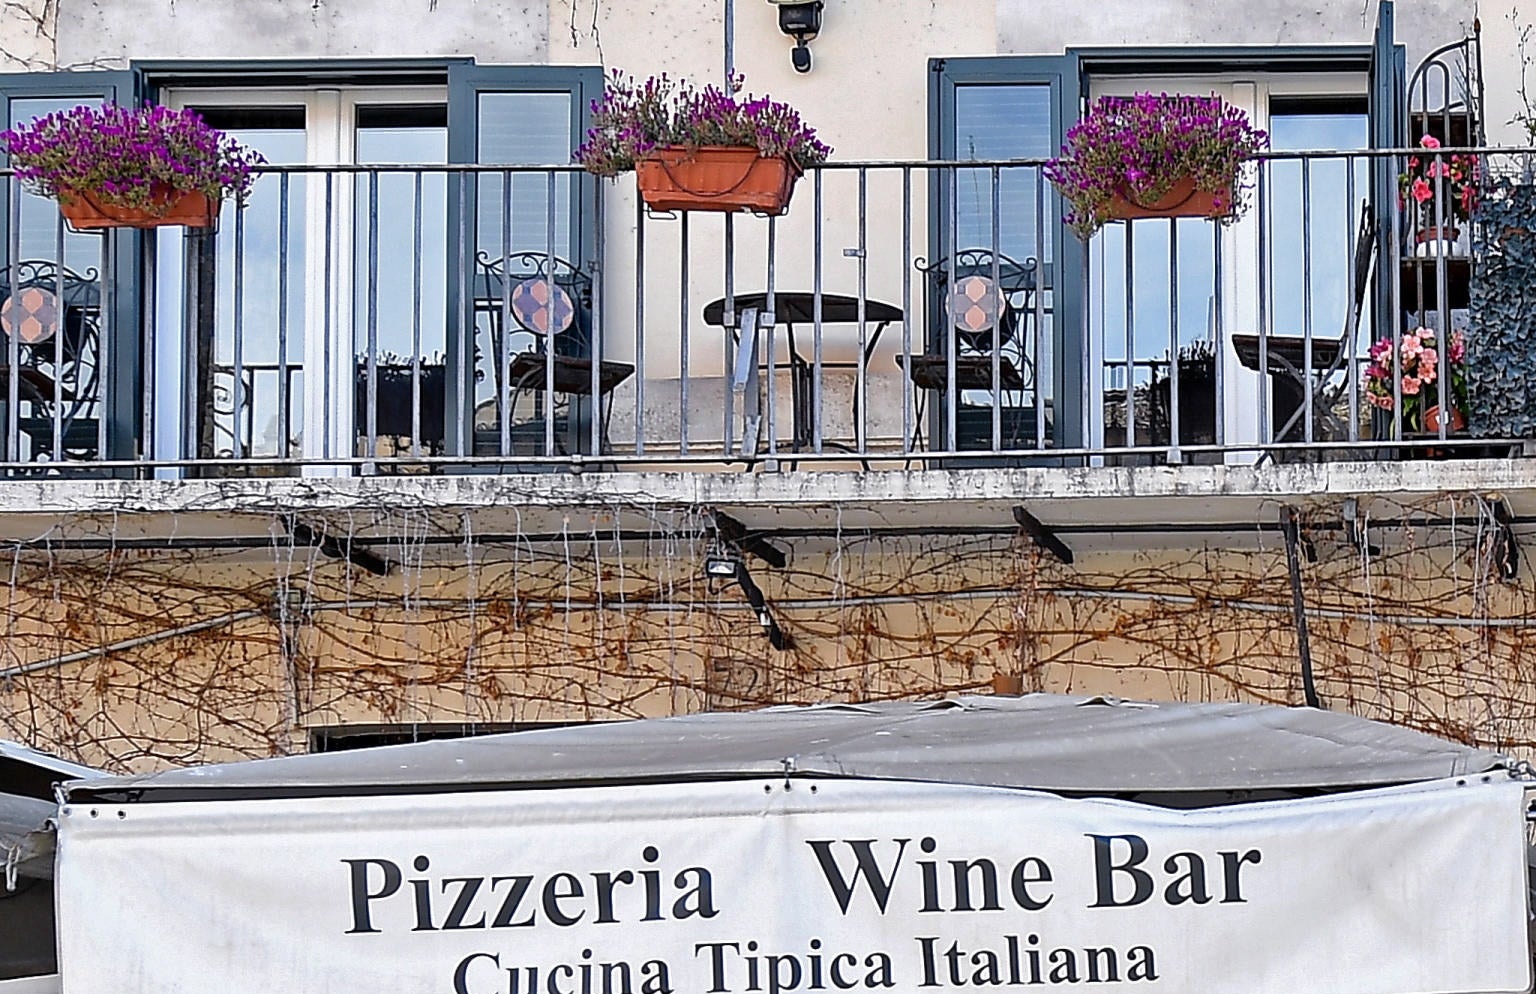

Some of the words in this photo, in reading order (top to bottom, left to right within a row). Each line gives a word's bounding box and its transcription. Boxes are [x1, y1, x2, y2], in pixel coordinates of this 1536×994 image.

[341, 845, 719, 936] Pizzeria
[806, 837, 1053, 916] Wine
[1085, 833, 1262, 909] Bar
[915, 934, 1160, 988] Italiana
